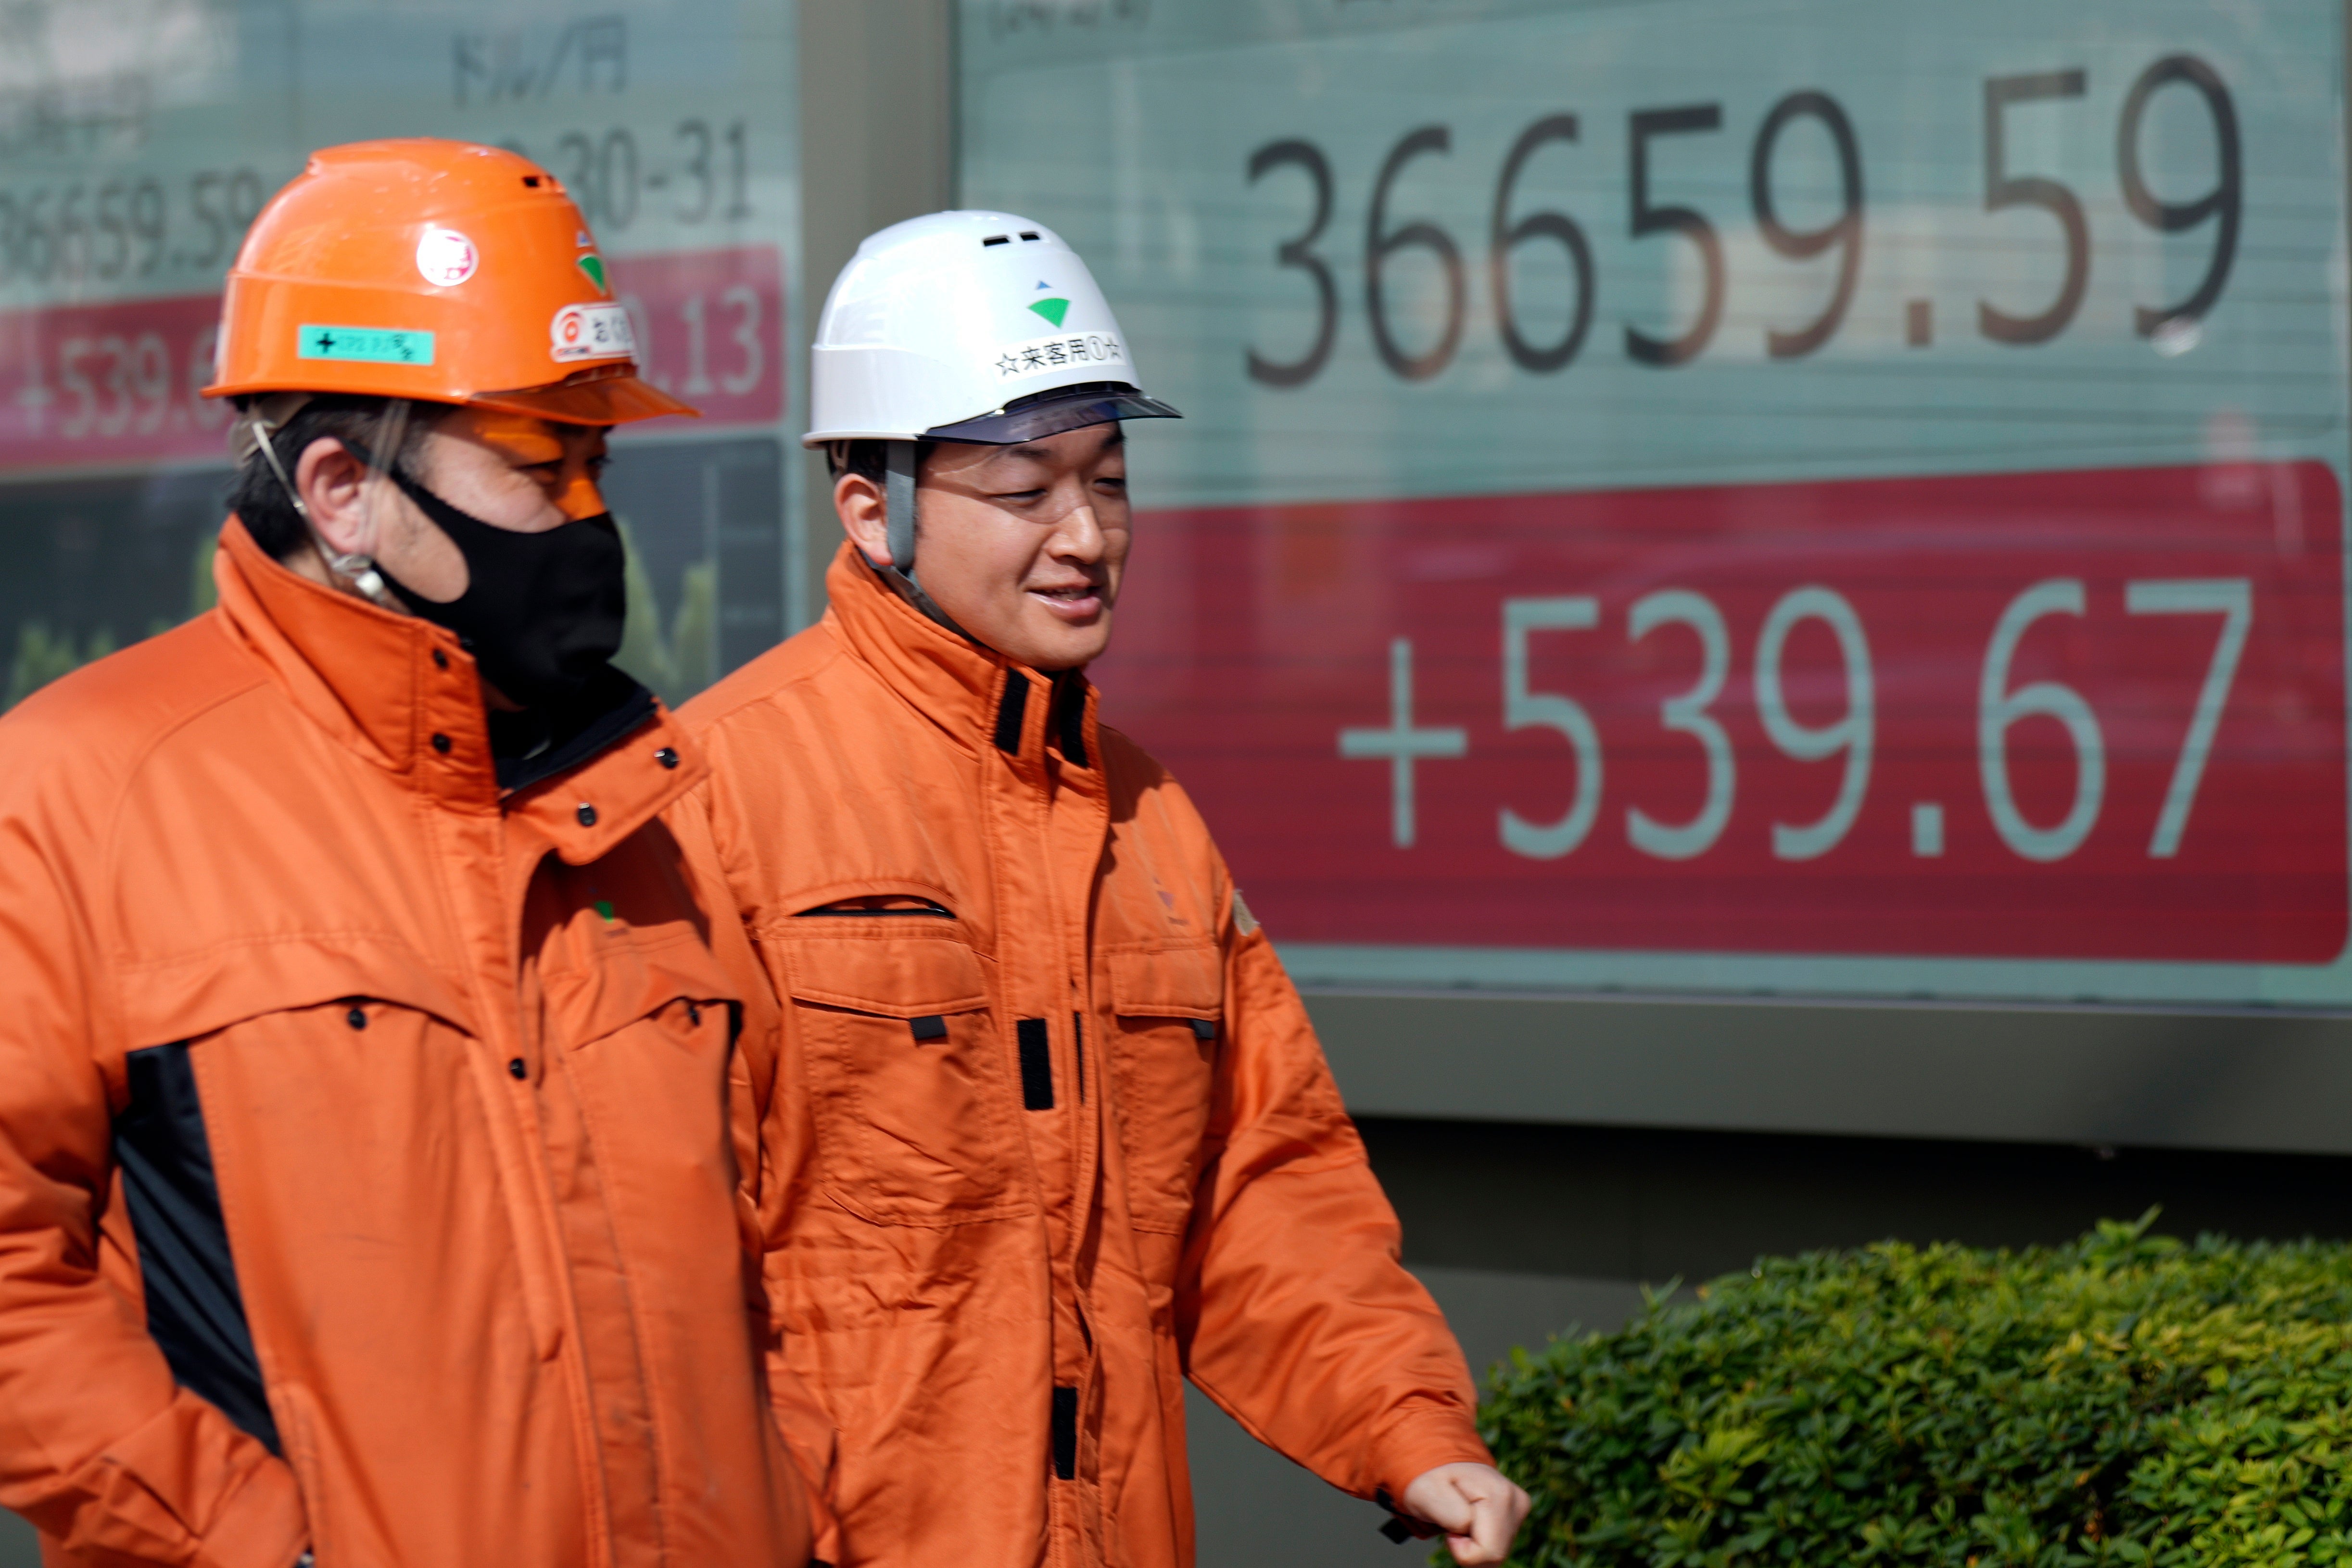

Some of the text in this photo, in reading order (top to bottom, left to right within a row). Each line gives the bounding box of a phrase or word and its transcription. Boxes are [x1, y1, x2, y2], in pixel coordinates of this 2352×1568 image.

[1245, 53, 2242, 389] 36659.59
[14, 325, 228, 439] +539.6
[1339, 579, 2253, 861] +539.67
